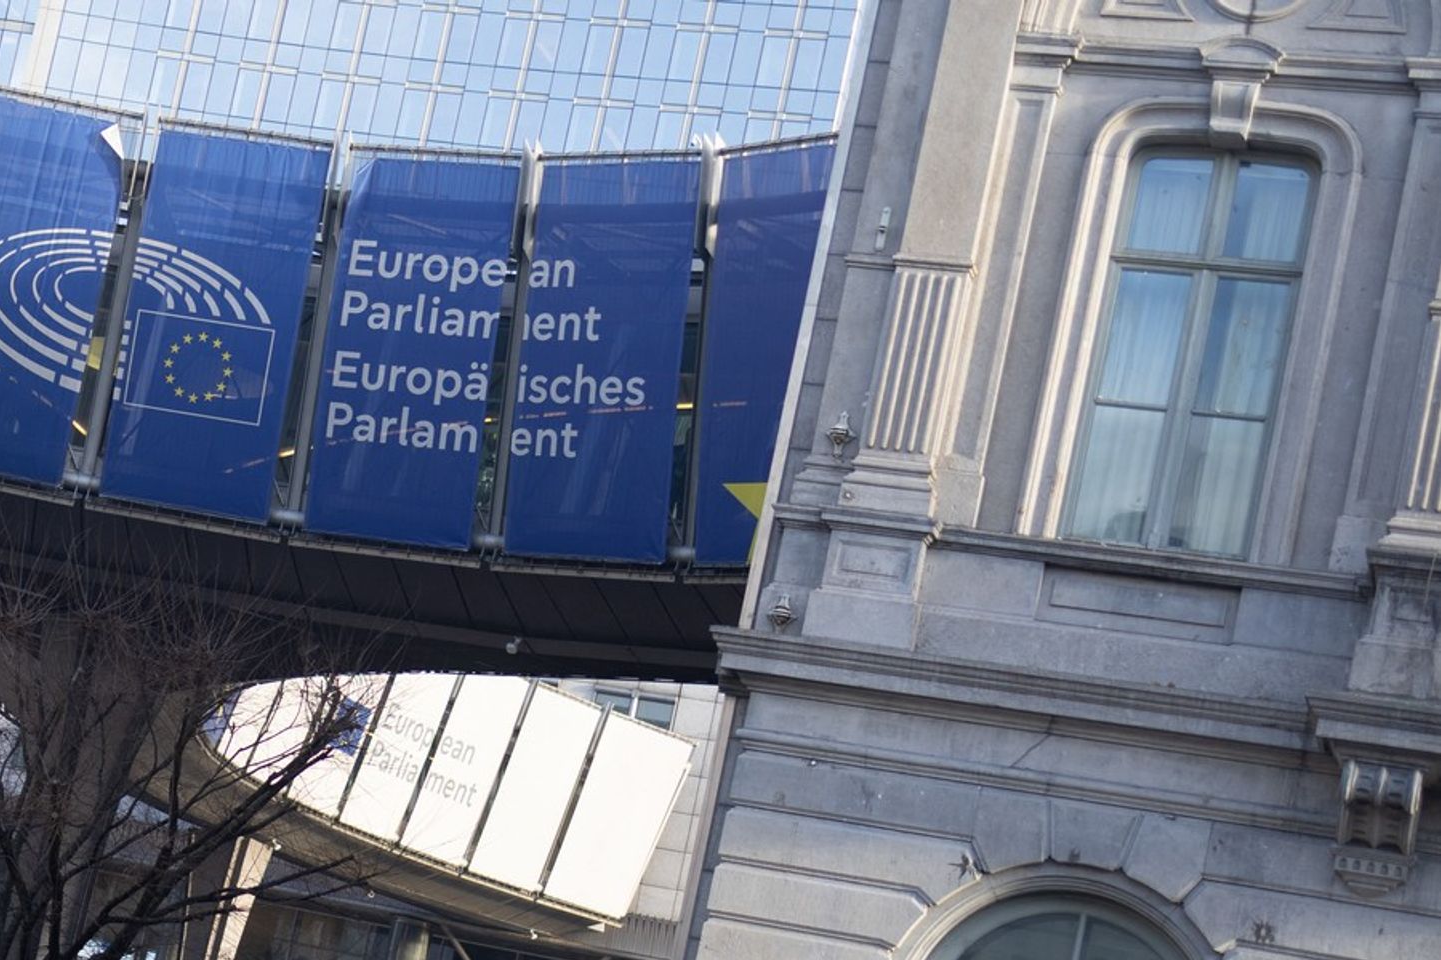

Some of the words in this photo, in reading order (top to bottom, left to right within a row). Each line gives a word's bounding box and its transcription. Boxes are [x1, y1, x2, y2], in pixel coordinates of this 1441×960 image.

[347, 239, 576, 292] European
[339, 290, 602, 342] Parliament
[331, 350, 646, 406] Europäisches
[325, 402, 578, 459] Parlament
[382, 701, 476, 765] European
[367, 740, 477, 808] Parliament
